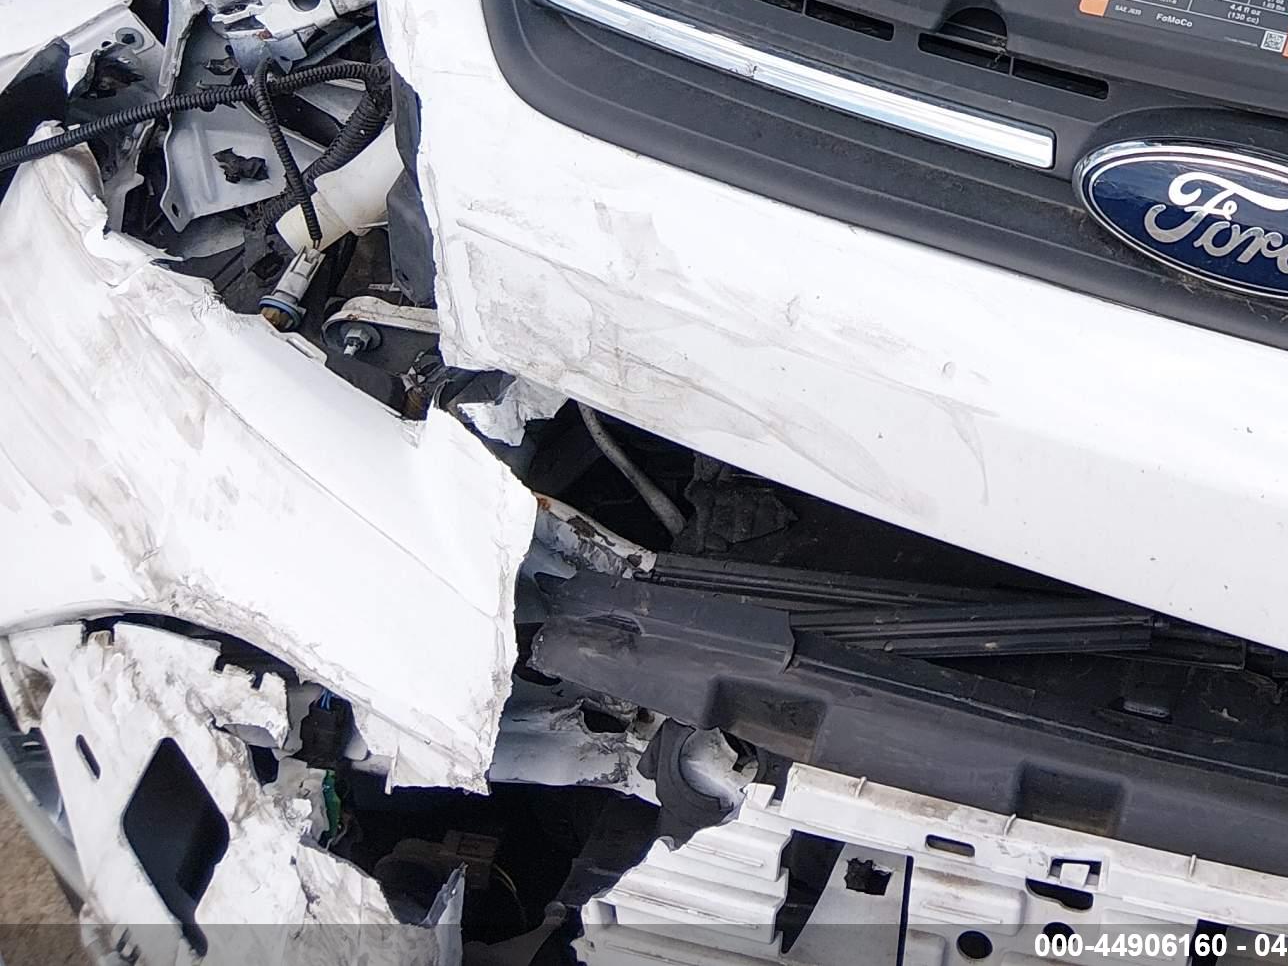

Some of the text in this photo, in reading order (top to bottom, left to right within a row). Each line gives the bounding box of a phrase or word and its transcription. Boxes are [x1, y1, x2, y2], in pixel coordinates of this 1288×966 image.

[1230, 3, 1243, 12] 4.4
[1250, 8, 1262, 16] oz
[1156, 13, 1193, 27] FoMoCo
[1227, 11, 1260, 25] (130 cc)
